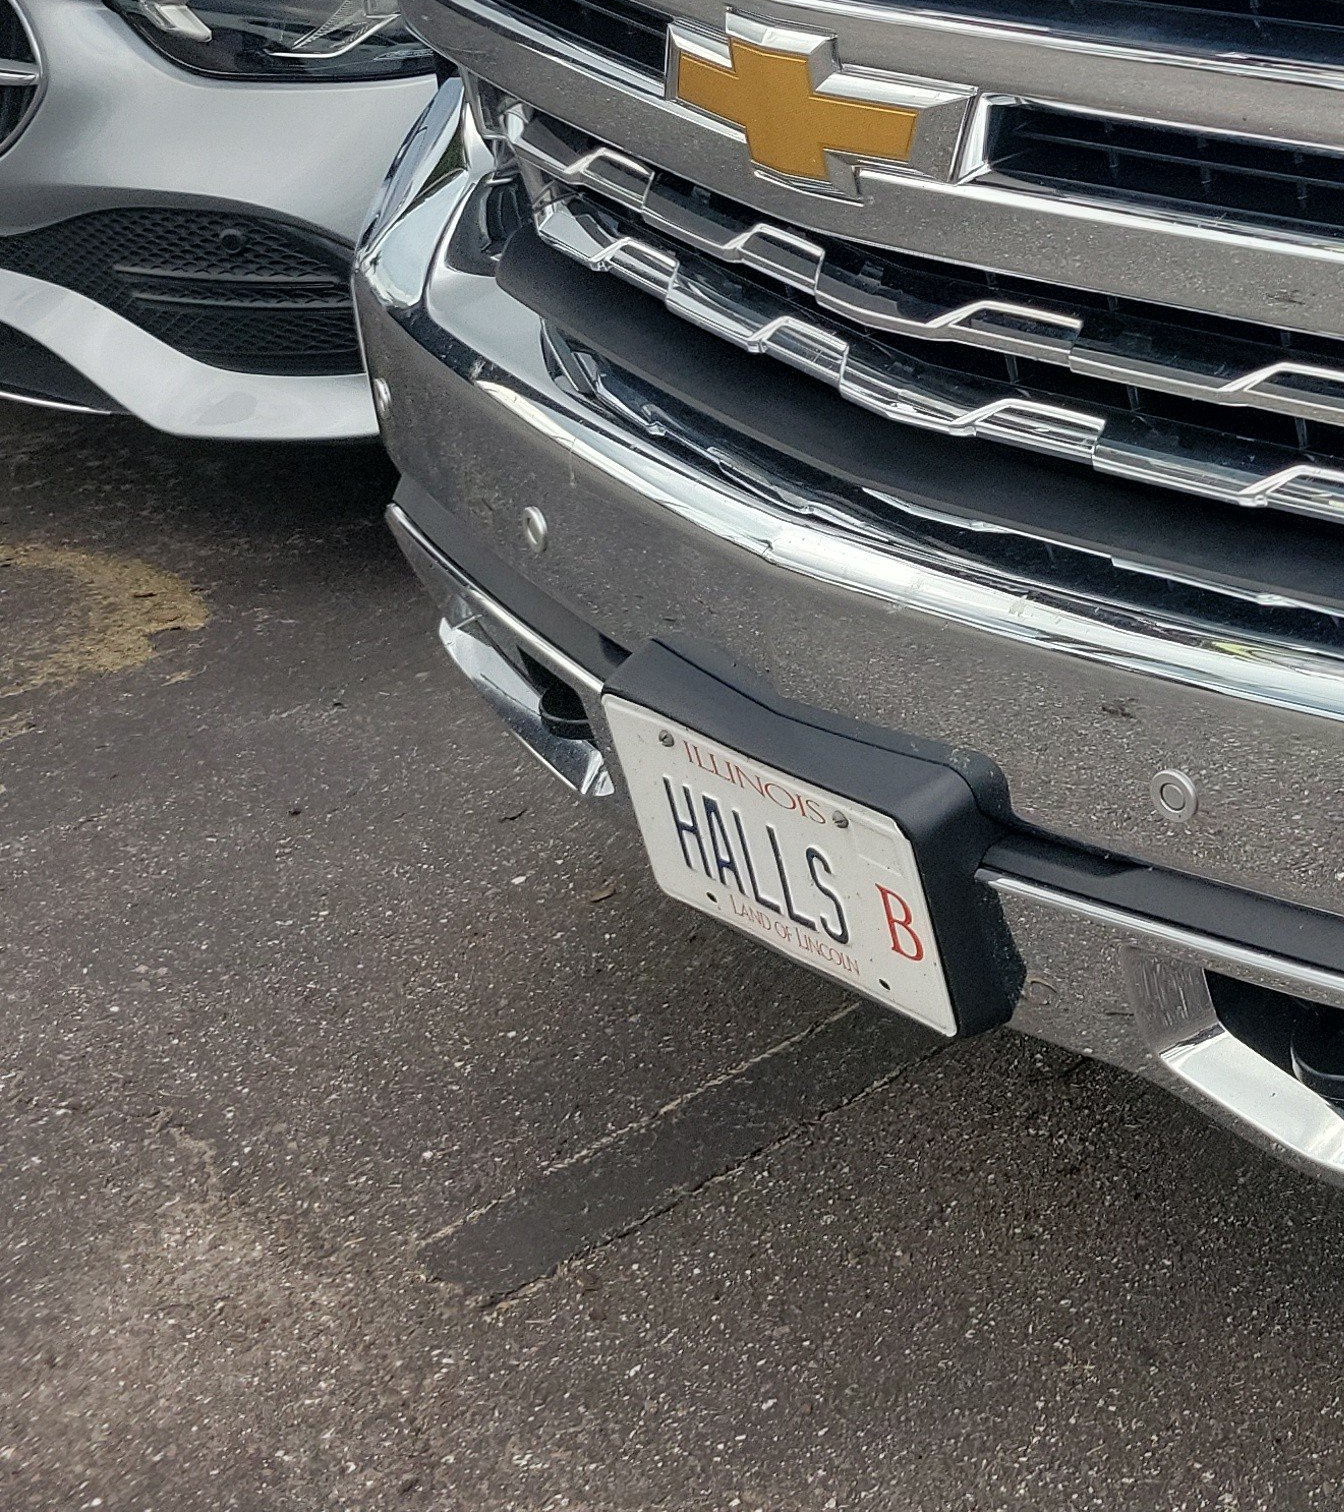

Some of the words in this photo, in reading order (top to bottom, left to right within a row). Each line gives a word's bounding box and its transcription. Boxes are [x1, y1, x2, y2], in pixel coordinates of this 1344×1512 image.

[683, 740, 826, 824] ILLINOIS
[662, 776, 849, 945] HALLS
[875, 883, 924, 962] B
[730, 894, 771, 930] LAND
[774, 921, 791, 942] OF
[795, 927, 860, 977] LINCOLN
